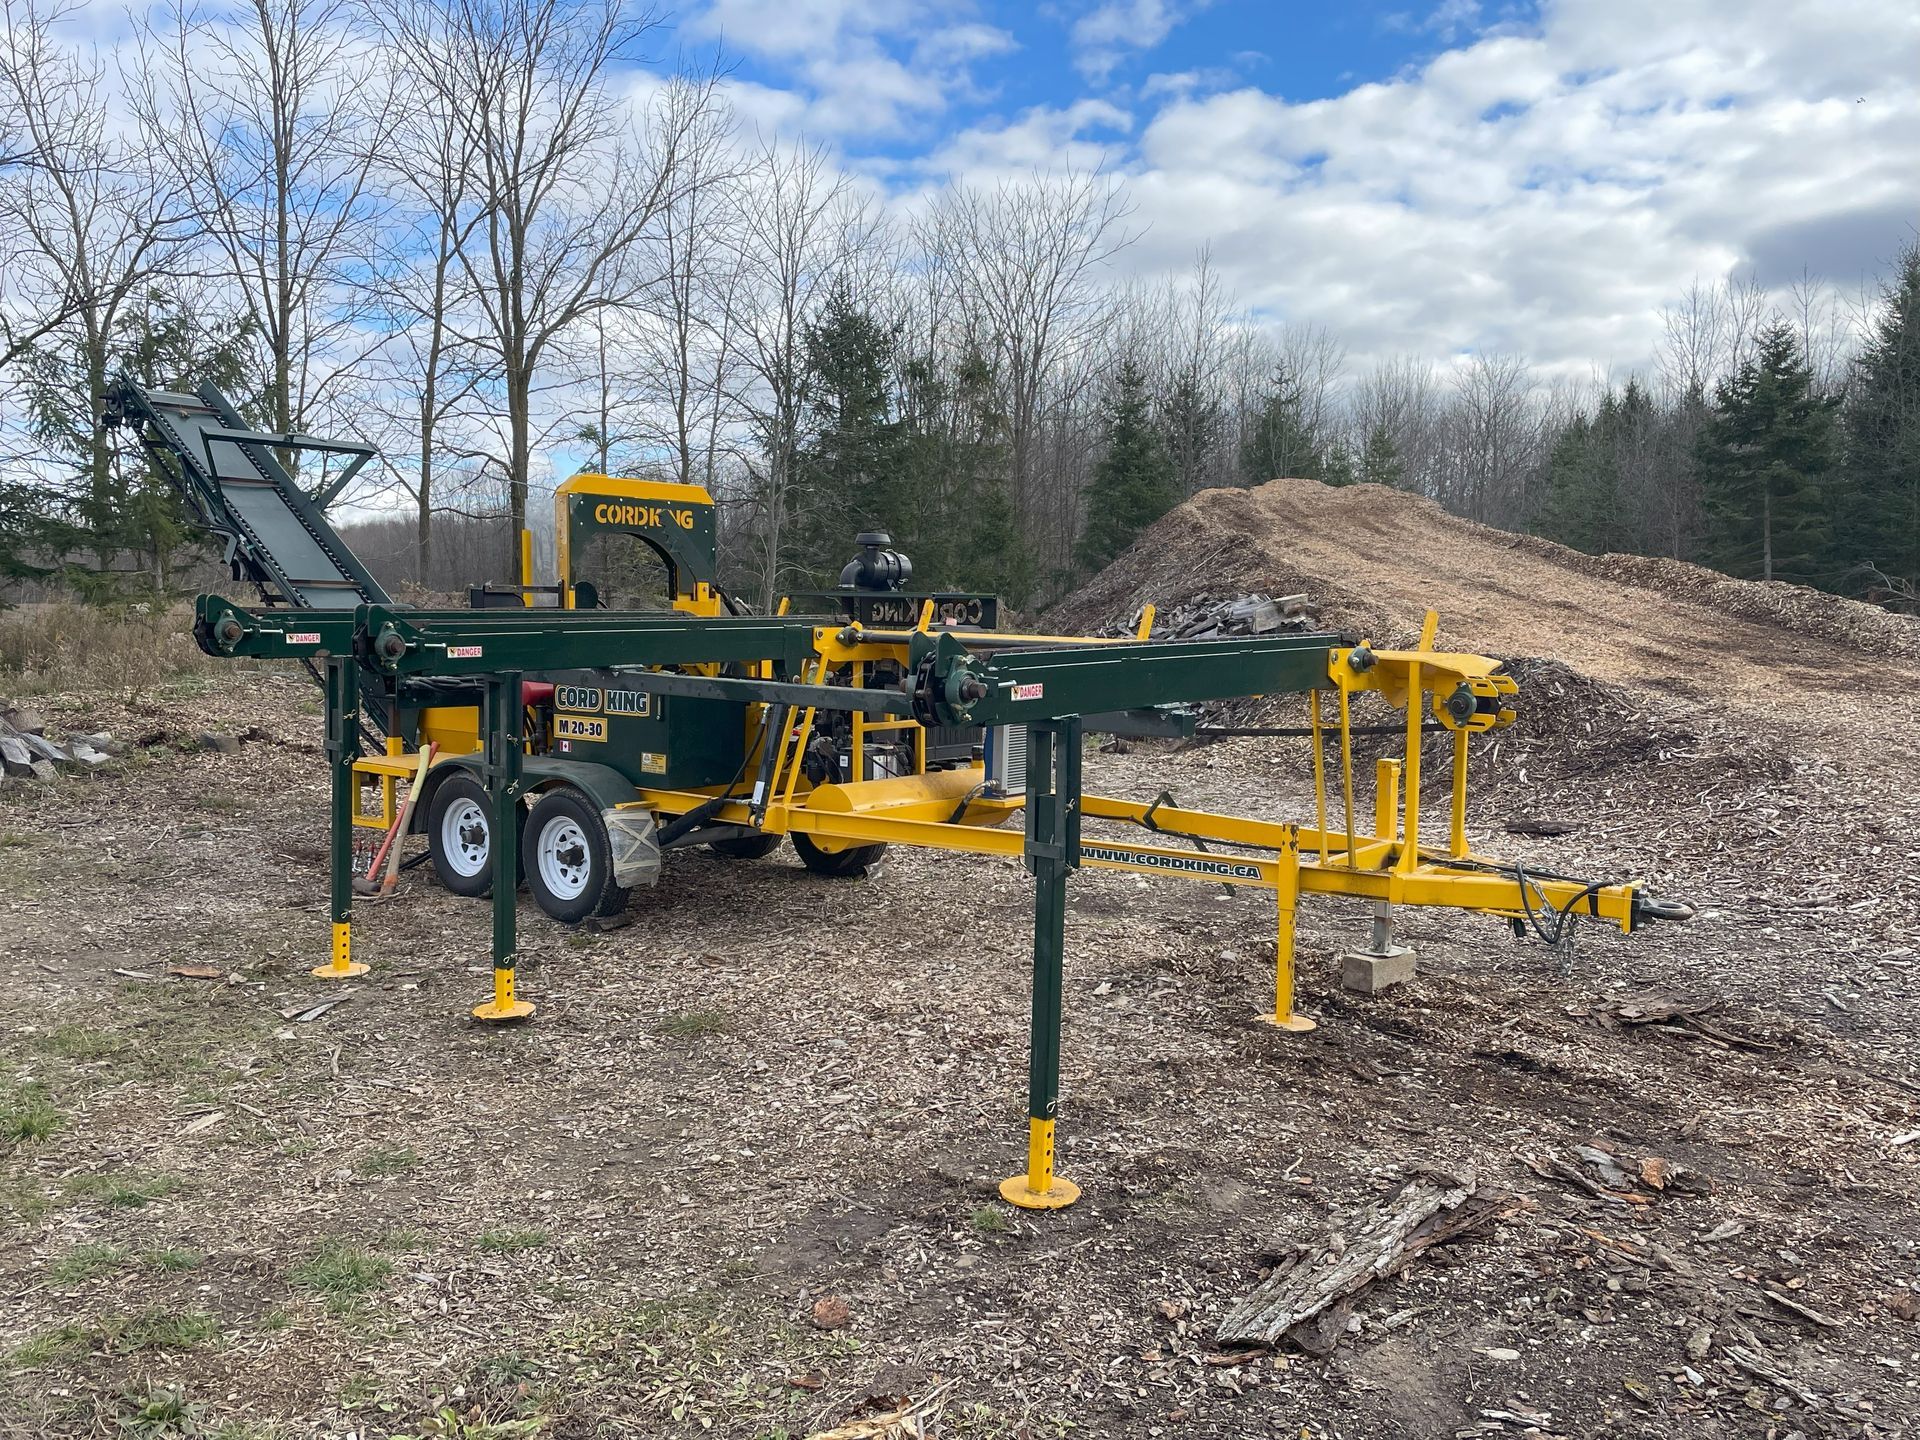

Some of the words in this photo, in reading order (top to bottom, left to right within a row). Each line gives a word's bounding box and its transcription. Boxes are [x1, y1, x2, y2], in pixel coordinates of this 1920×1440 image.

[595, 503, 694, 530] CORDKNG
[295, 634, 320, 642] DANGER
[456, 647, 481, 657] DANGER
[557, 686, 600, 710] CORD
[605, 689, 649, 714] KING
[1020, 684, 1042, 698] DANGER
[558, 719, 569, 734] M
[571, 720, 603, 737] 20-30
[1080, 846, 1260, 879] WWW.CORDKING.CA
